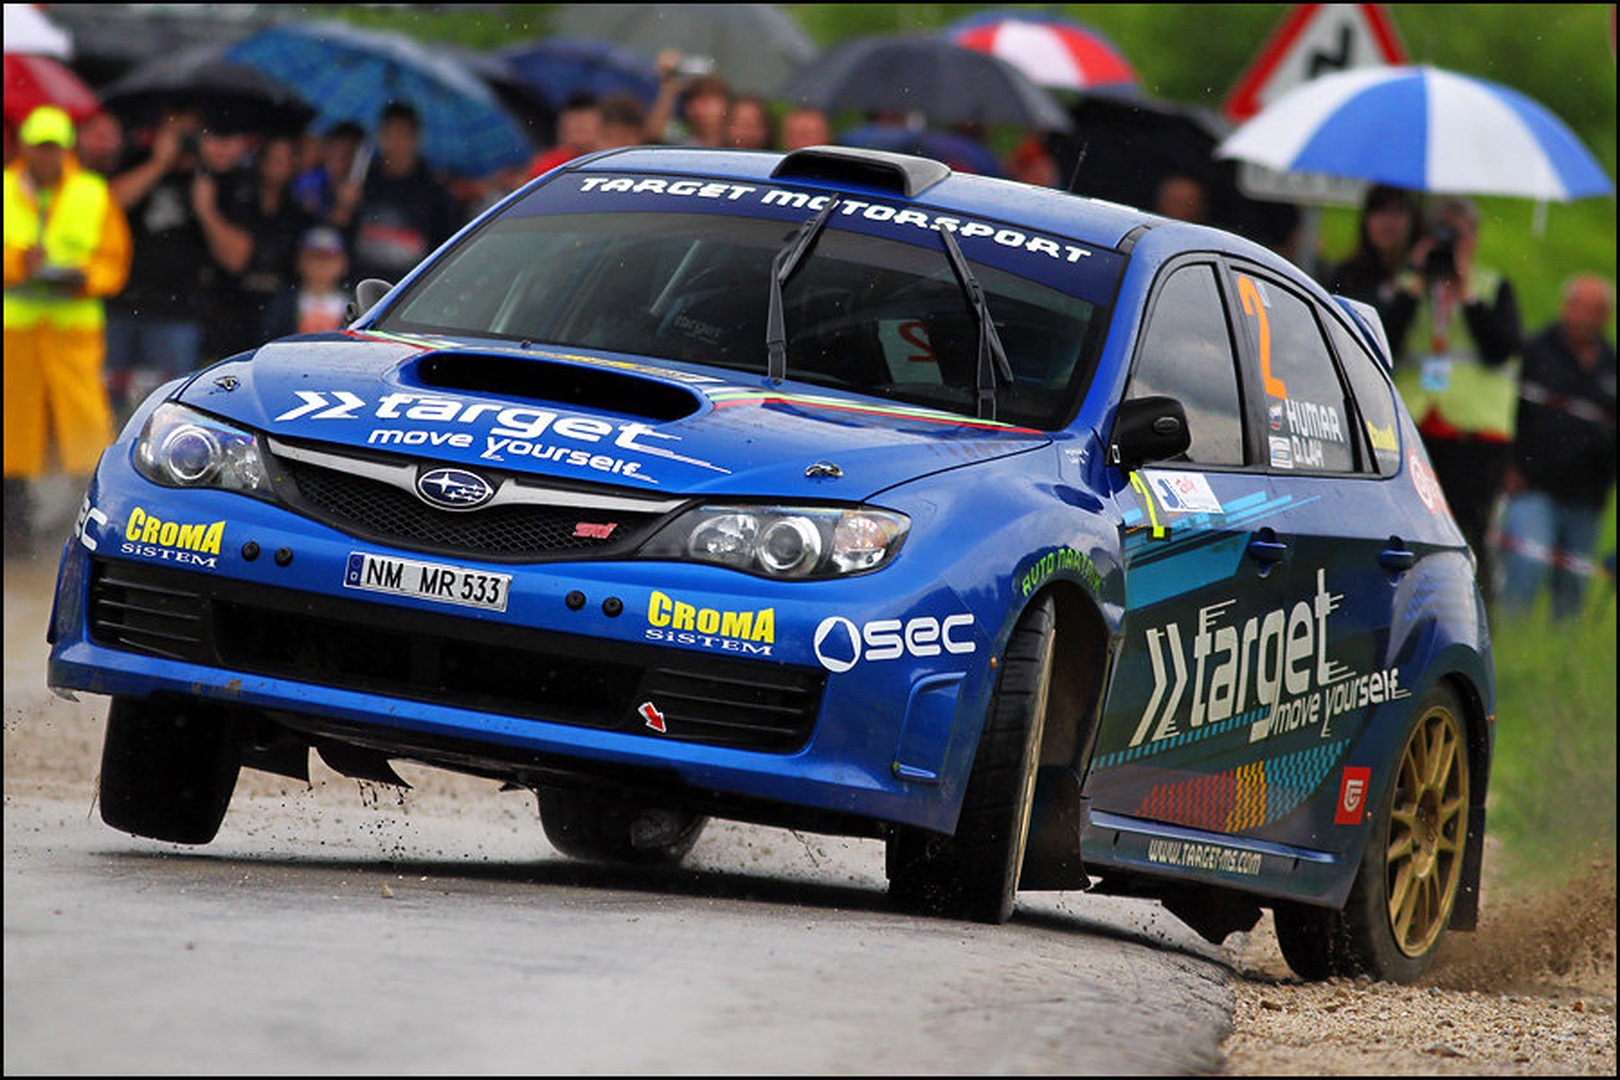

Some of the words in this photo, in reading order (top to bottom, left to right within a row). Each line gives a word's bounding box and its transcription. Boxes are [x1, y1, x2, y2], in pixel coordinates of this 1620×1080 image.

[579, 177, 758, 200] TARGET
[761, 189, 1092, 263] MOTORSPORT
[1238, 275, 1287, 400] 2
[377, 394, 705, 465] target
[1285, 399, 1345, 443] HUMAR
[368, 429, 472, 448] move
[479, 434, 658, 484] yourself
[125, 506, 227, 555] CROMA
[366, 557, 404, 588] NM
[419, 566, 456, 597] MR
[461, 575, 500, 604] 533
[1022, 552, 1056, 597] AUTO
[647, 590, 775, 644] CROMA
[1190, 568, 1356, 743] target
[1272, 692, 1320, 736] move
[1320, 668, 1411, 738] yourself
